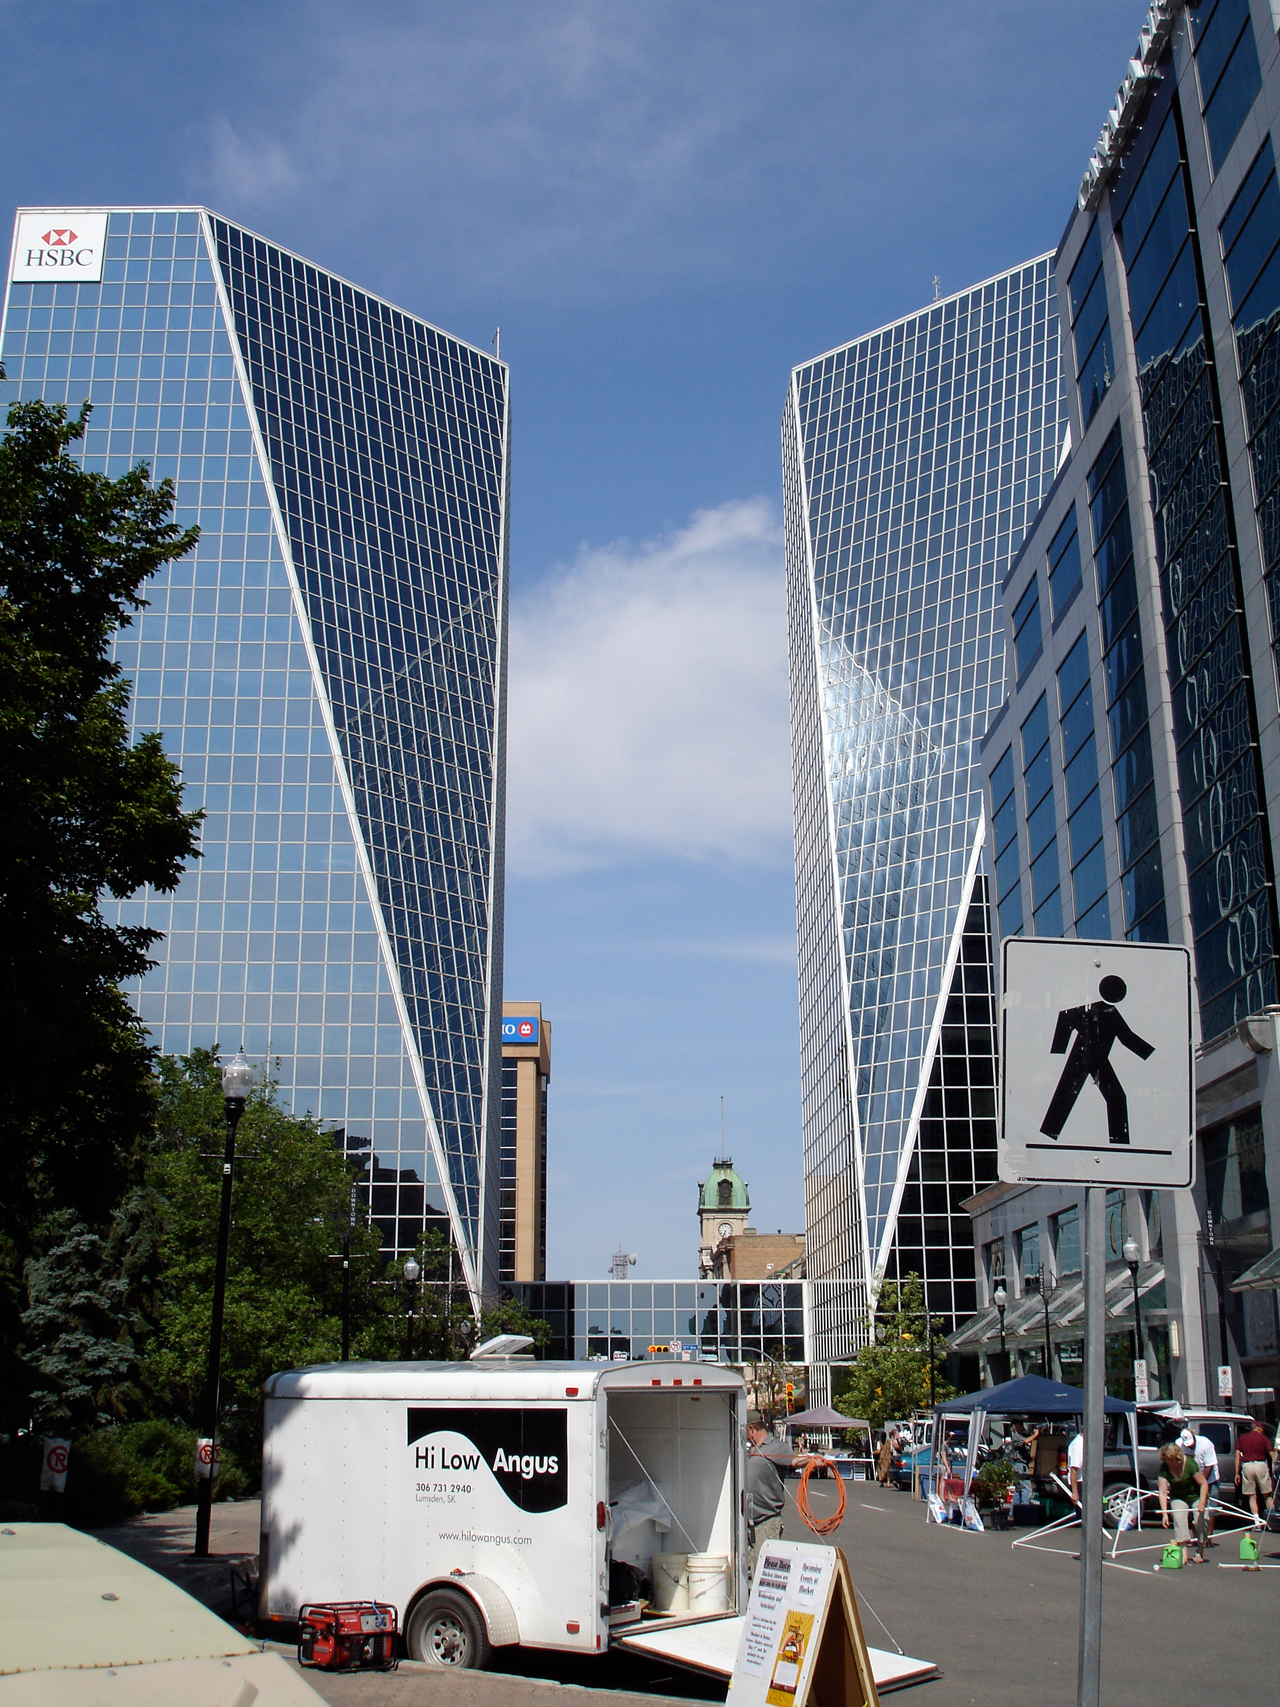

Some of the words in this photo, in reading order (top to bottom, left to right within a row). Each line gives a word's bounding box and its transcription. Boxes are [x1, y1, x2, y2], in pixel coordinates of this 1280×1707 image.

[24, 248, 94, 267] HSBC
[415, 1446, 435, 1469] Hi
[441, 1447, 481, 1470] Low
[493, 1447, 559, 1480] Angus
[415, 1483, 431, 1492] 306
[433, 1483, 447, 1493] 731
[450, 1484, 472, 1494] 2940
[415, 1494, 446, 1504] Lumsden,
[447, 1495, 456, 1503] SK
[438, 1530, 533, 1547] www.hilowangus.com
